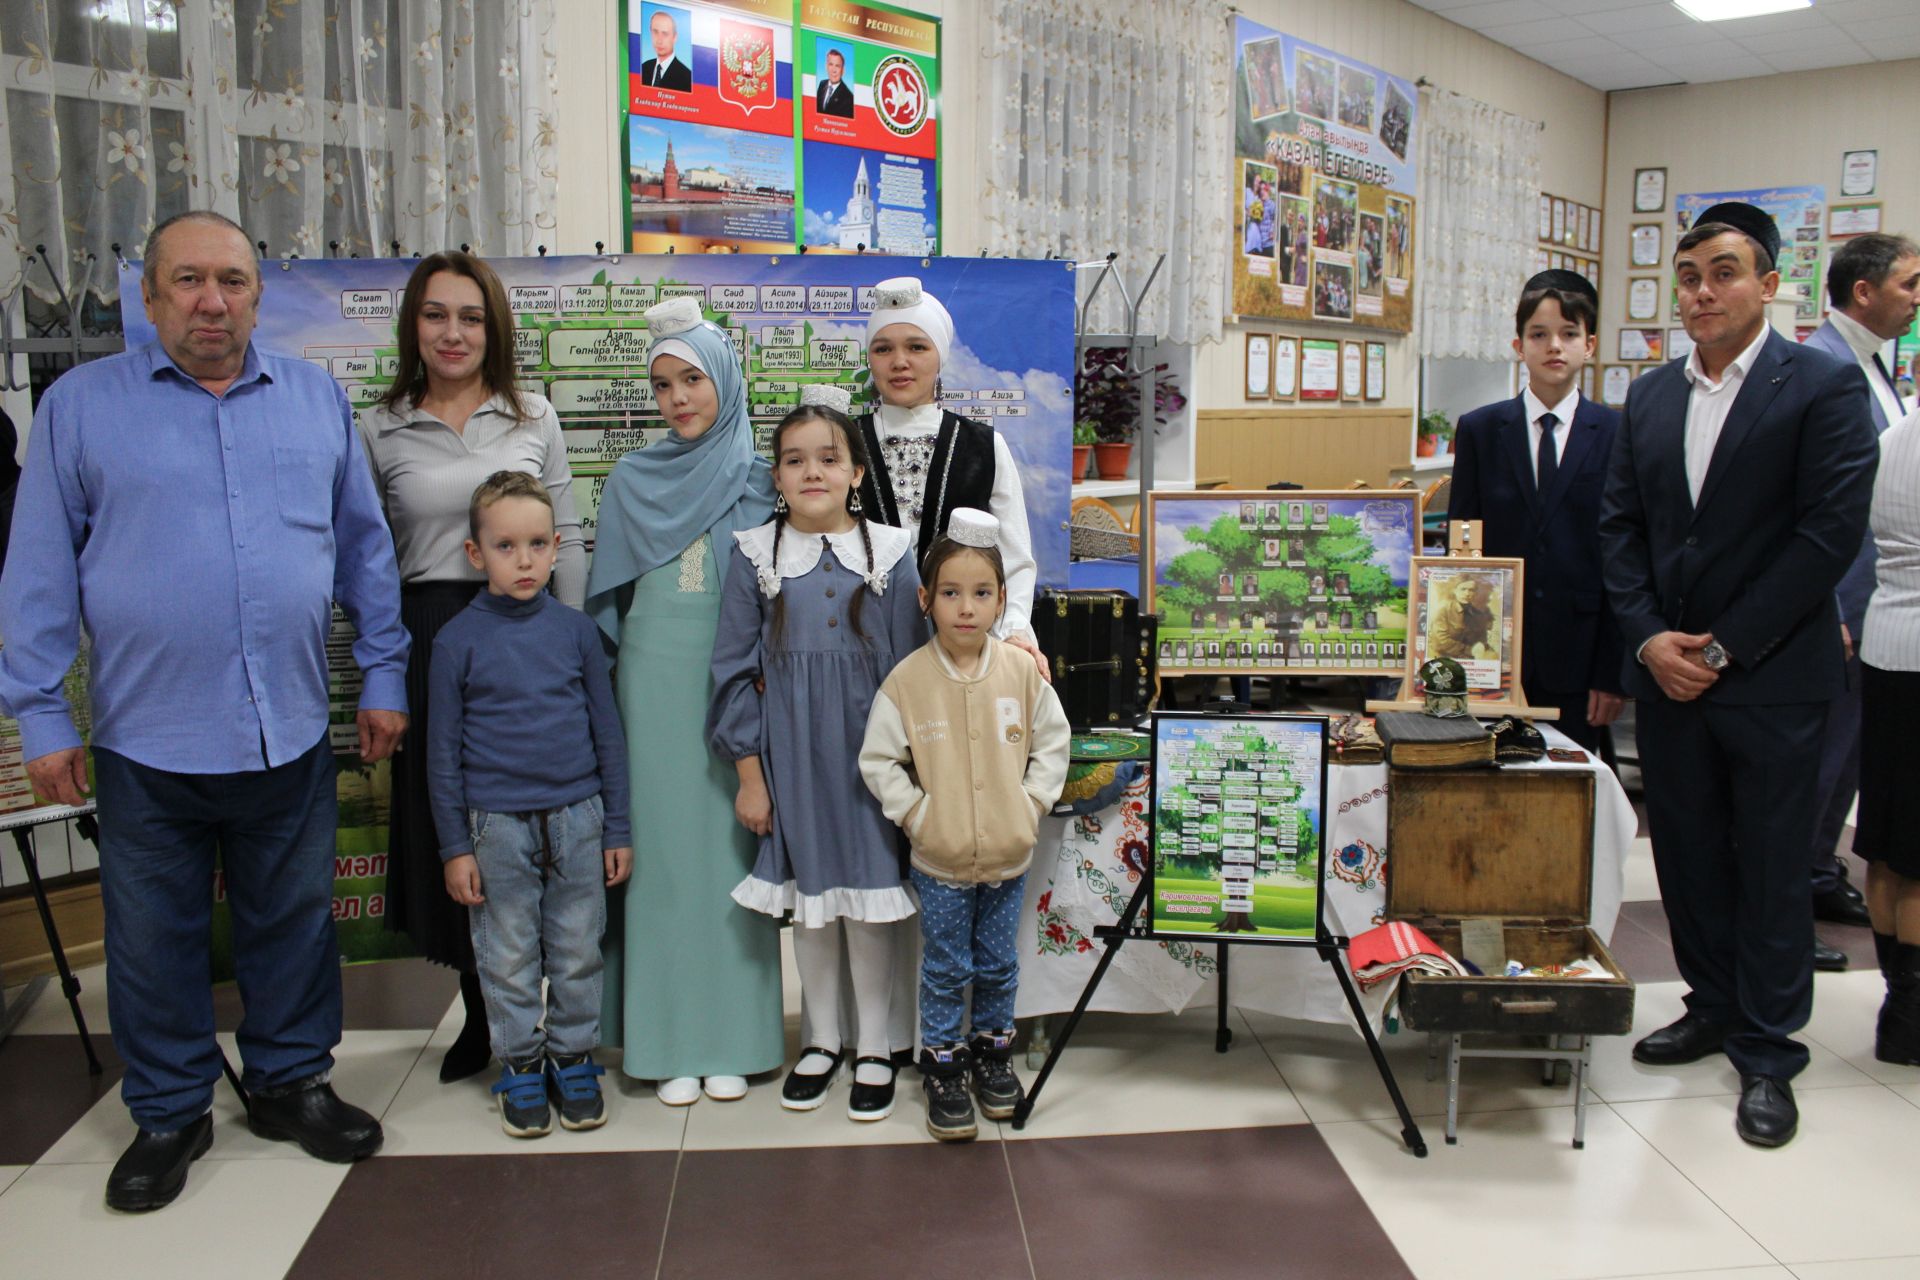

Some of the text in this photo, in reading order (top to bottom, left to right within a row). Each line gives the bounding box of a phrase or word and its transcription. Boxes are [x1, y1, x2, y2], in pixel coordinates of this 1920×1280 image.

[576, 287, 592, 295] Аяз
[620, 287, 646, 295] Камал
[561, 299, 607, 311] (13.11.2012)
[711, 301, 756, 311] (26.04.2012)
[344, 306, 392, 317] (06.03.2020)
[606, 329, 633, 340] Азат
[771, 337, 794, 346] (1990)
[346, 361, 368, 371] Раян
[769, 382, 786, 391] Роза
[603, 429, 644, 440] Вакыйф
